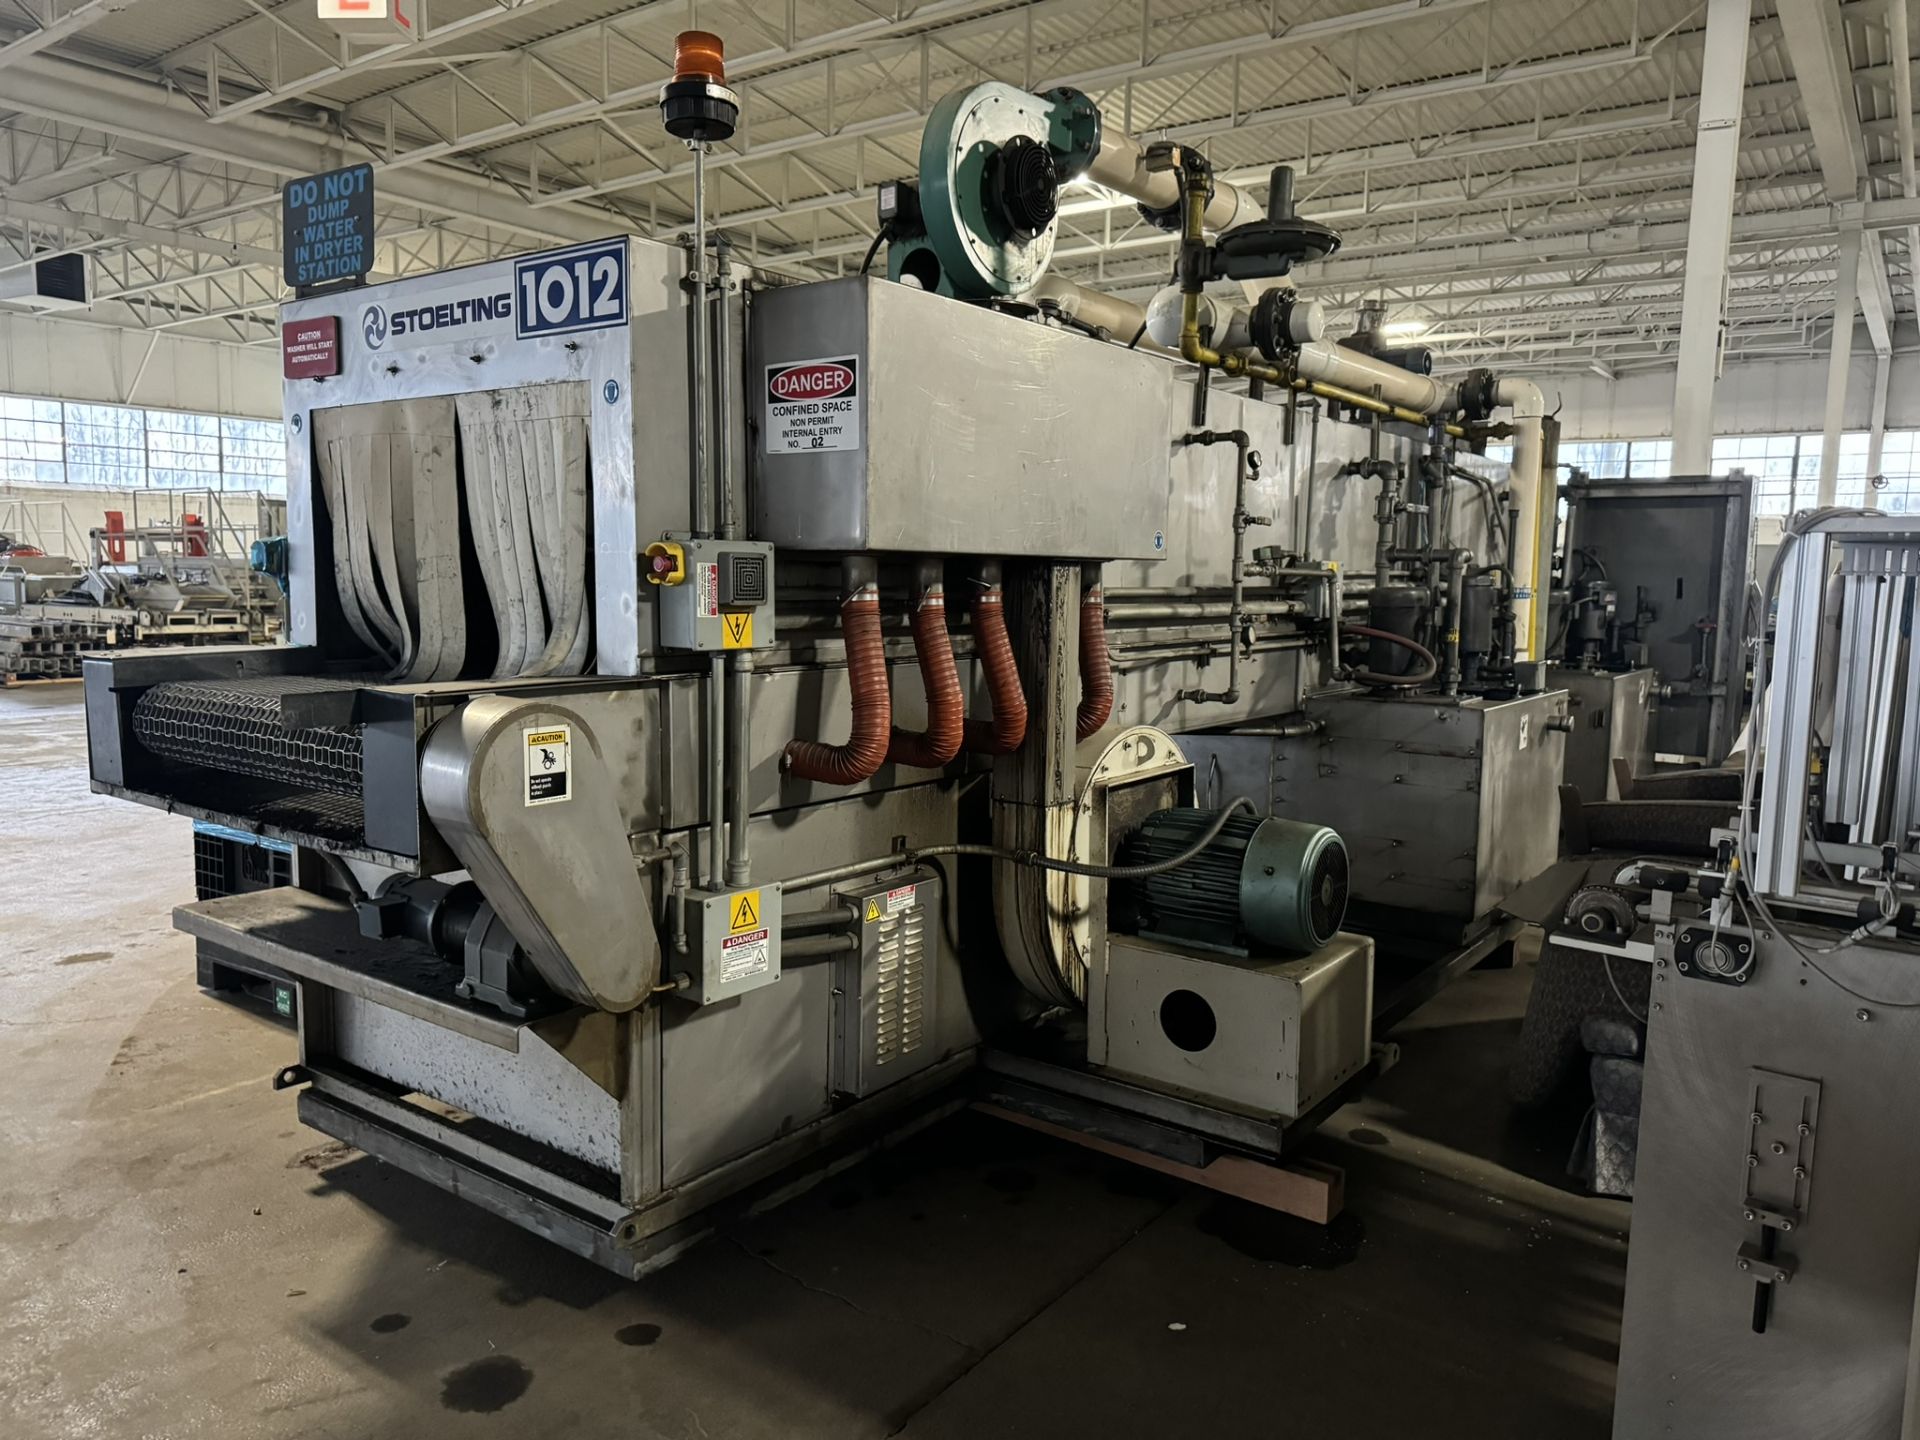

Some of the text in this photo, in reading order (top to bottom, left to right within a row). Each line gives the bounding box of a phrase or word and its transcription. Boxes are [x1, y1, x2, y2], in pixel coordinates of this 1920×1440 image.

[290, 168, 368, 208] DO NOT
[308, 199, 349, 223] DUMP
[303, 217, 354, 243] WATER
[295, 235, 363, 264] IN DRYER
[298, 254, 361, 281] STATION
[522, 255, 620, 327] 1012
[391, 292, 512, 336] STOELTING
[297, 330, 321, 342] CAUTION
[318, 340, 333, 349] START
[778, 370, 845, 394] DANGER
[772, 400, 852, 417] CONFINED SPACE
[782, 425, 843, 438] INTERNAL ENTRY
[790, 416, 834, 427] NON PERMIT
[788, 436, 824, 448] NO. 02
[536, 734, 563, 743] CAUTION
[732, 931, 765, 946] DANGER
